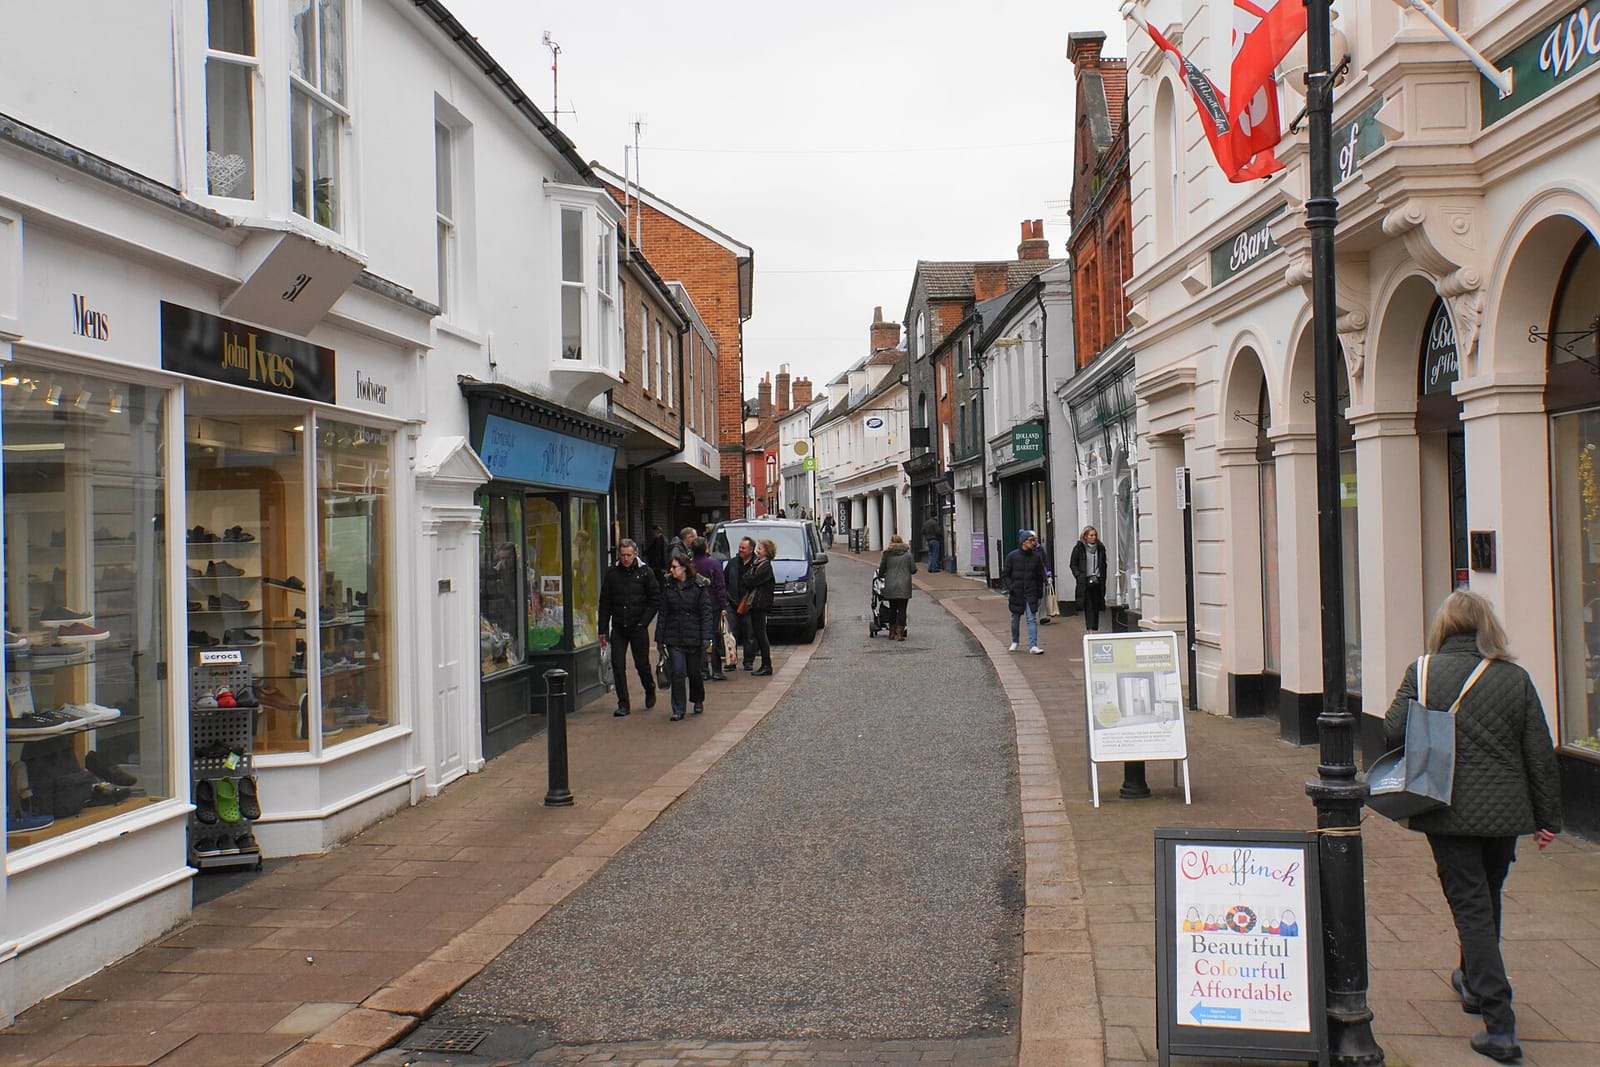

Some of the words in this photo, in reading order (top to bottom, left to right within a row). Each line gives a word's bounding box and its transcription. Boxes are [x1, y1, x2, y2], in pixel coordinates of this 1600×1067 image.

[1340, 123, 1359, 181] of
[1230, 231, 1278, 271] Barr
[281, 273, 312, 303] 31
[71, 292, 110, 342] Mens
[221, 332, 249, 370] John
[247, 332, 295, 389] Ives
[356, 369, 387, 405] Footwear
[1181, 848, 1300, 887] Chaffinch
[1191, 934, 1290, 958] Beautiful
[1194, 958, 1287, 980] Colourful
[1190, 979, 1293, 1002] Affordable
